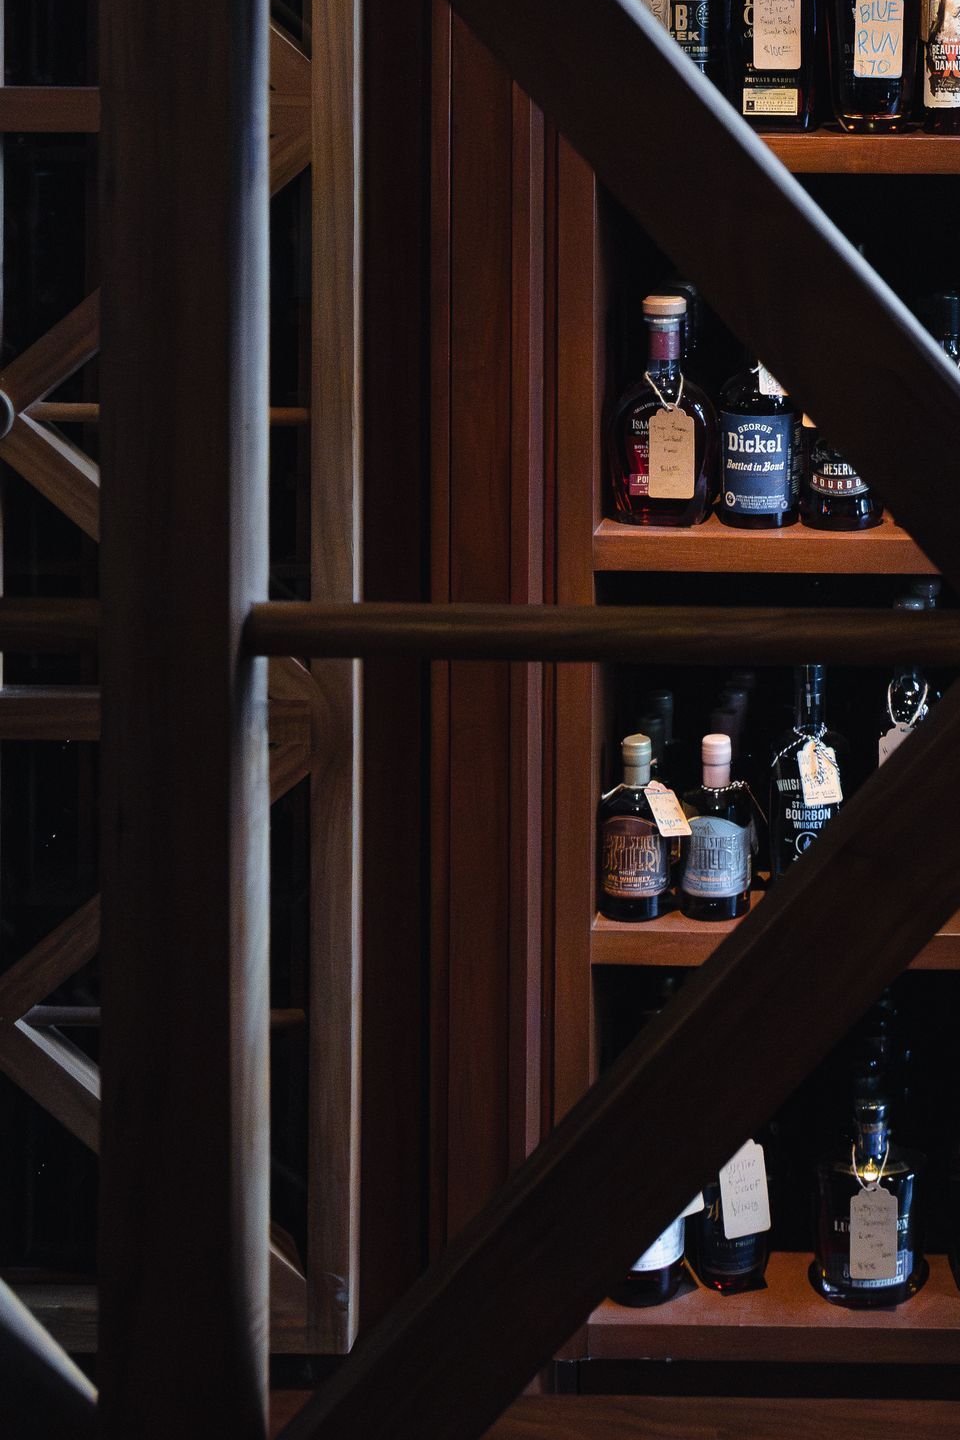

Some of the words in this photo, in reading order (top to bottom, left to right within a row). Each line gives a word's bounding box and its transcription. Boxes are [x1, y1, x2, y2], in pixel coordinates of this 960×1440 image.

[860, 1, 901, 24] BLUE
[858, 30, 899, 56] RUN
[737, 423, 773, 434] GEORGE
[727, 431, 783, 454] Dickel
[726, 458, 754, 472] Bottled
[753, 462, 762, 472] in
[761, 460, 785, 472] Bond
[785, 807, 831, 821] BOURBON
[792, 821, 823, 830] WHISKEY
